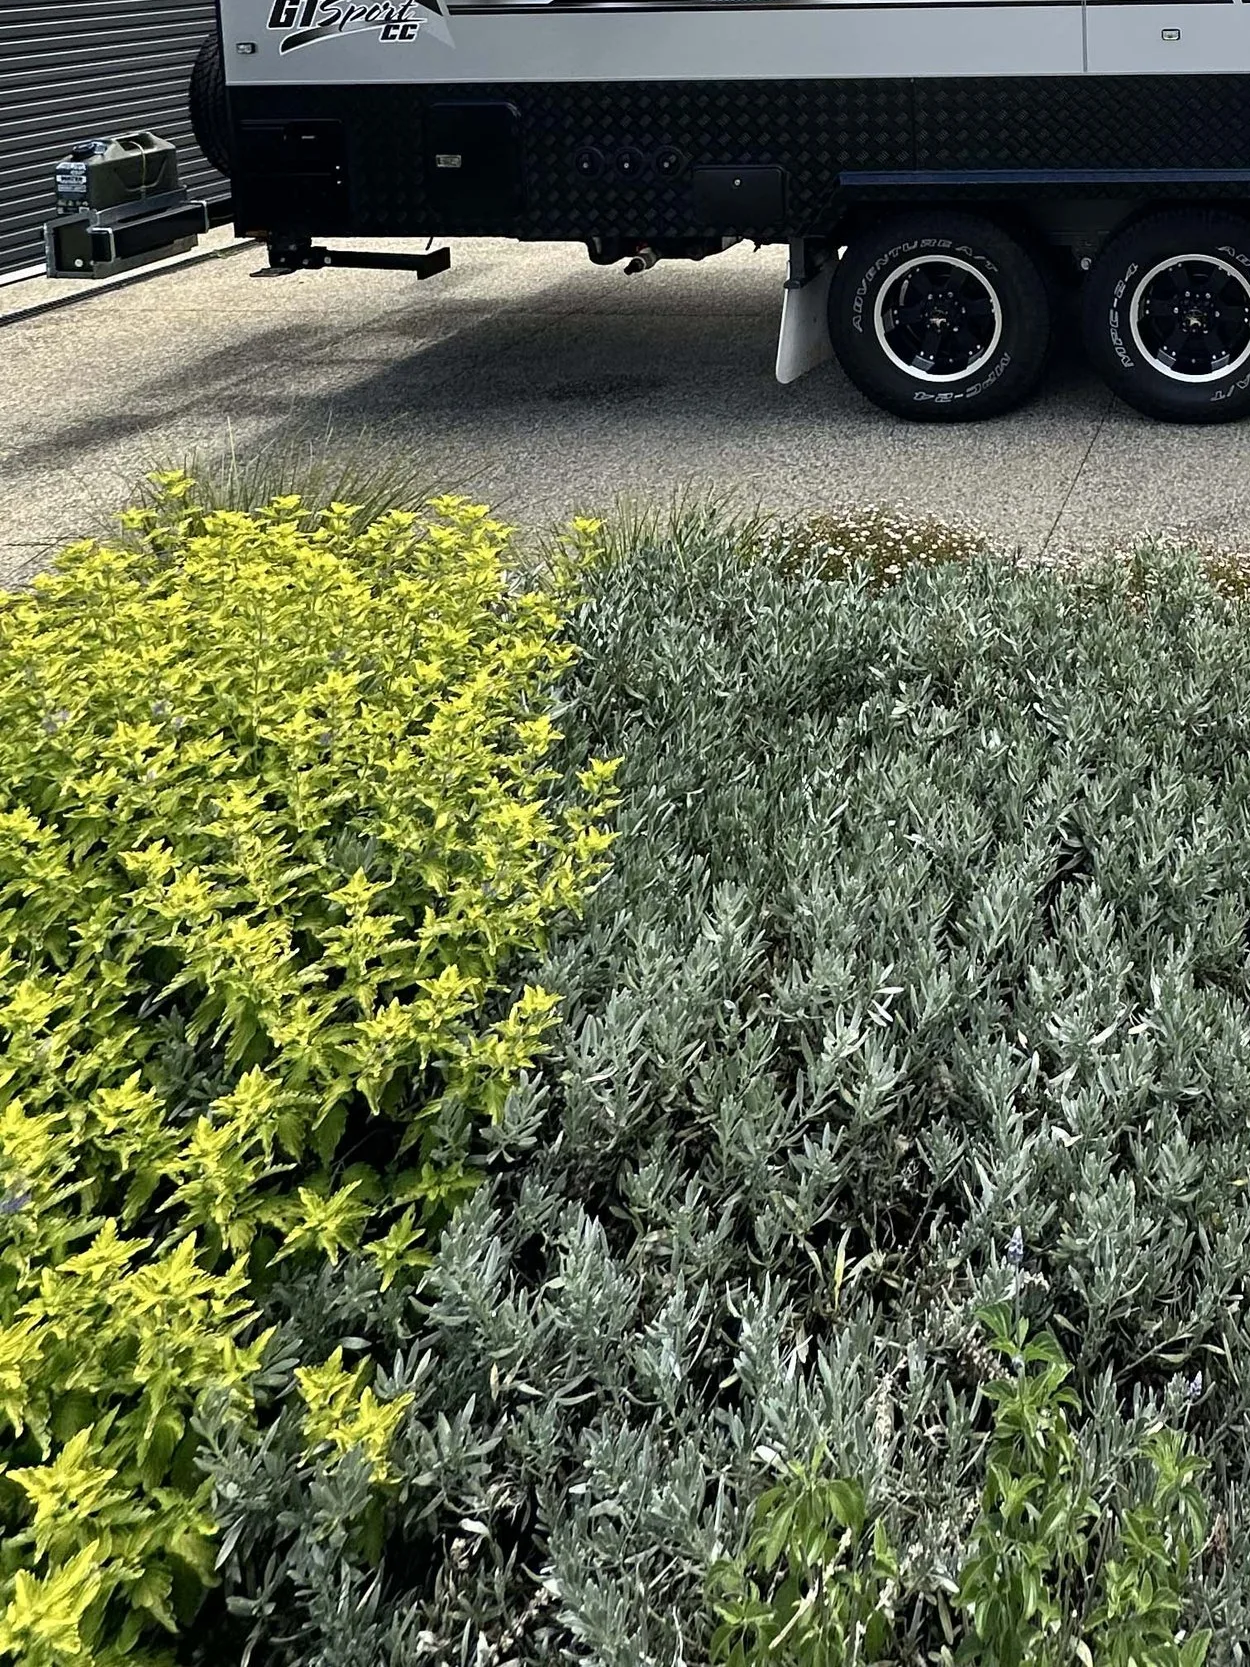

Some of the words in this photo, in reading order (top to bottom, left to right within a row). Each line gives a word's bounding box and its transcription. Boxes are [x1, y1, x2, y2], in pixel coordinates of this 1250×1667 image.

[379, 23, 420, 43] CC
[853, 239, 952, 333] ADVENTURE
[956, 246, 998, 272] A/T
[1210, 373, 1250, 401] A/T
